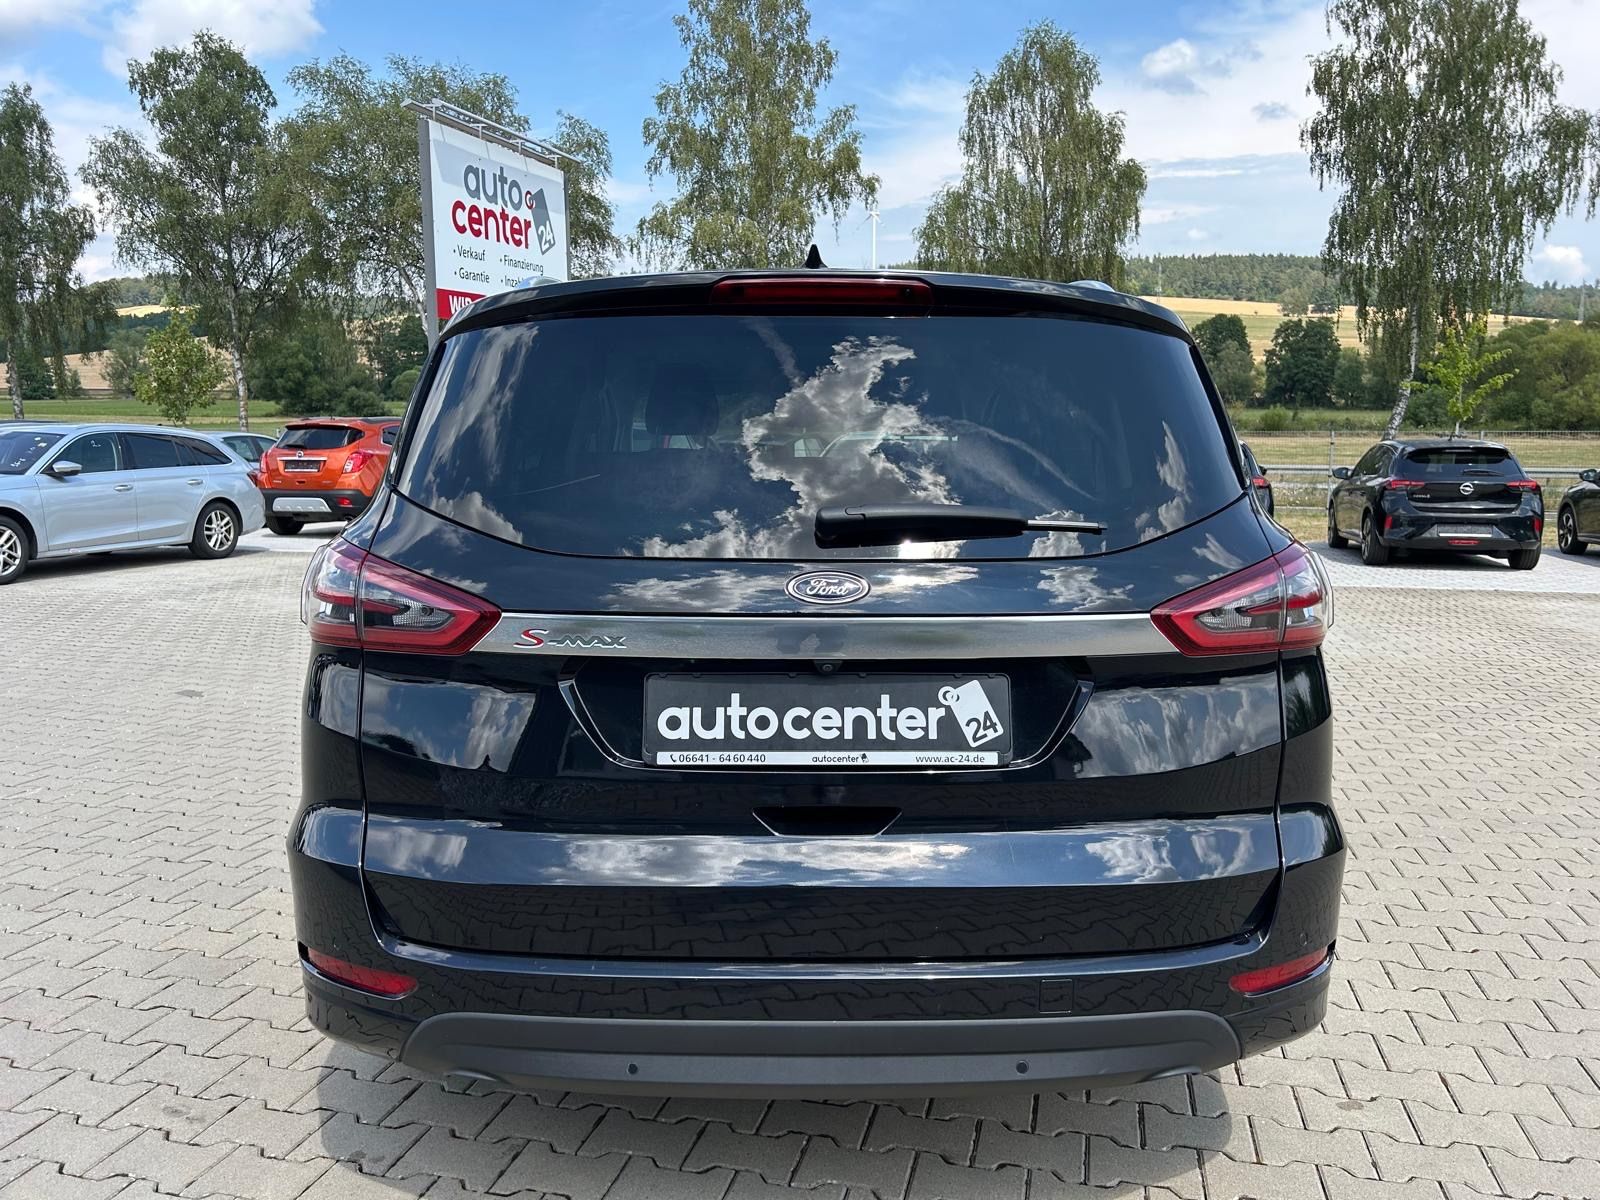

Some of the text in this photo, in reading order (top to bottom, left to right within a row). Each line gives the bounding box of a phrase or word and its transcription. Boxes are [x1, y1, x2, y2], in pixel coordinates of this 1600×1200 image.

[464, 165, 523, 211] auto
[452, 200, 531, 249] center
[538, 220, 554, 251] 24
[457, 244, 486, 261] Verkauf
[458, 267, 490, 283] Garantie
[503, 254, 544, 276] Finanzierung
[806, 578, 849, 596] Ford
[512, 628, 627, 649] S-MAX
[965, 710, 999, 744] 24
[811, 753, 859, 763] autocenter
[915, 753, 986, 763] www.ac-24.de
